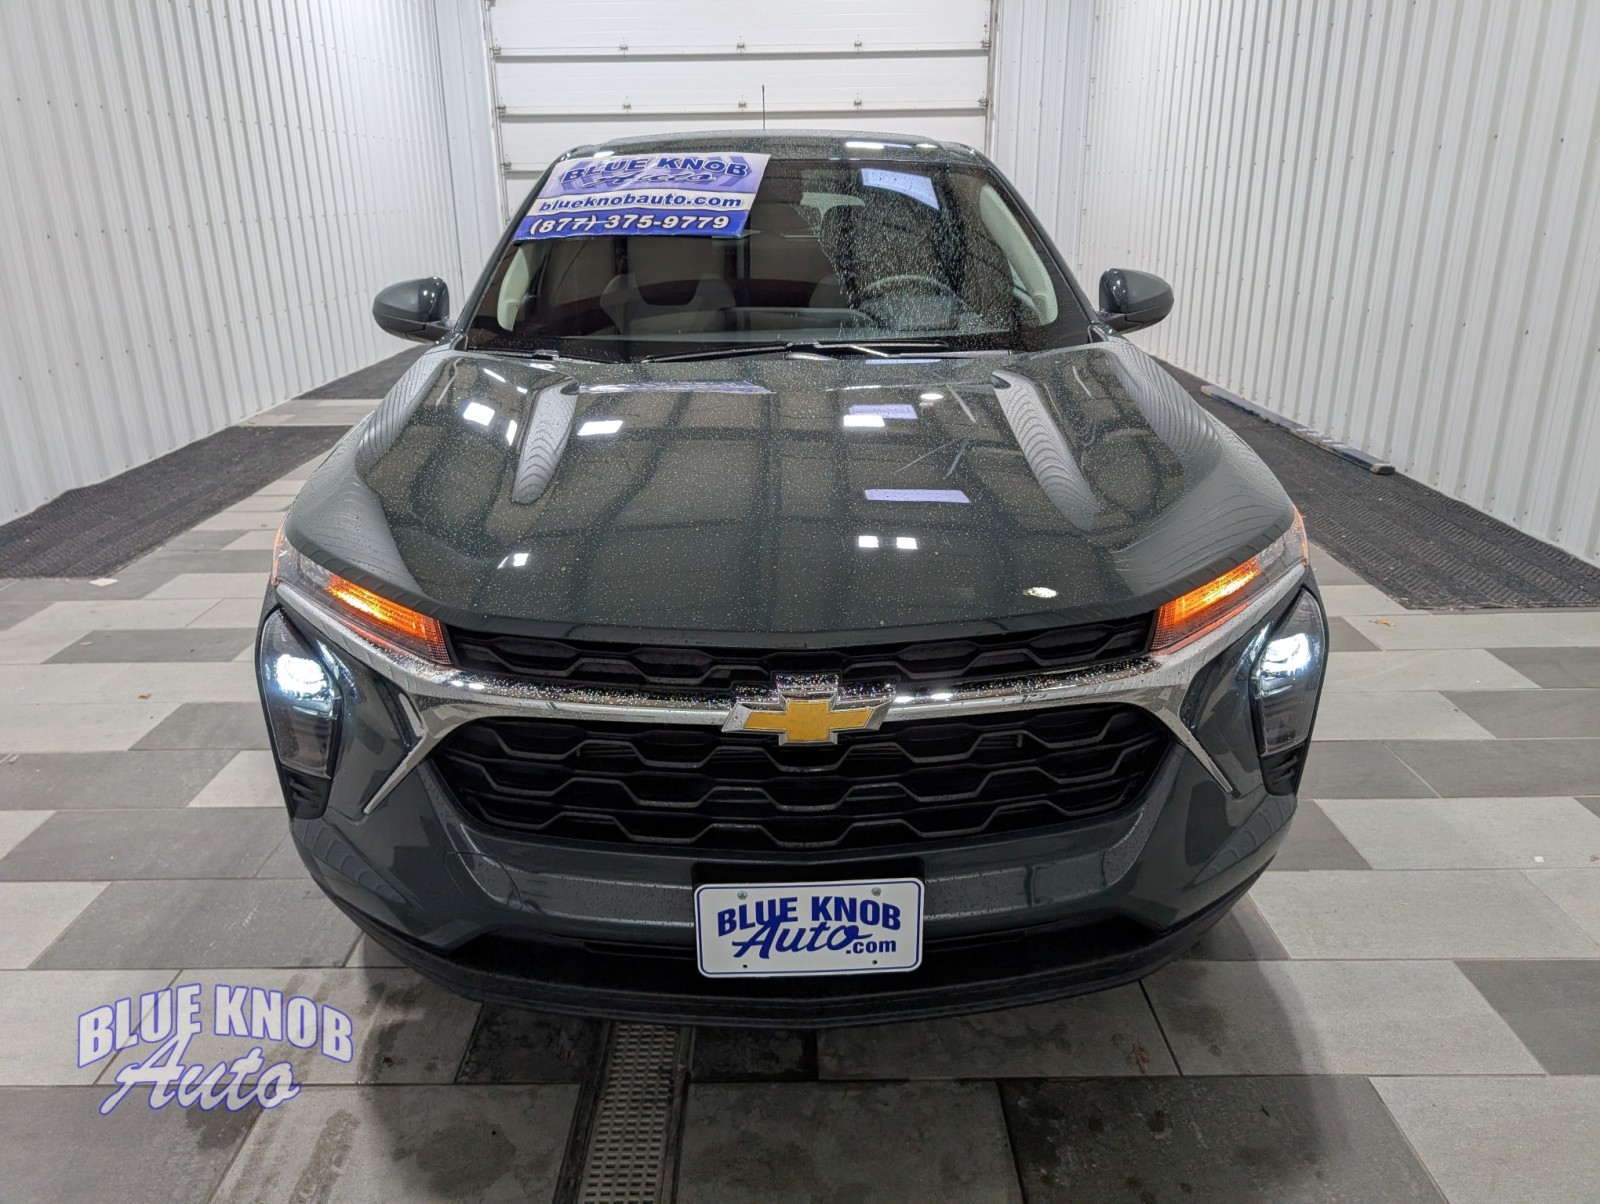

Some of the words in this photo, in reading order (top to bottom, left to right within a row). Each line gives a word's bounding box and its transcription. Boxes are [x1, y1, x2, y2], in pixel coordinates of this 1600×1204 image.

[561, 158, 649, 184] BLUE
[657, 156, 748, 177] KNOB
[582, 170, 717, 188] Auto
[539, 193, 742, 212] blueknobauto.com
[530, 215, 597, 235] (877)
[604, 214, 731, 230] 375-9779
[717, 896, 798, 937] BLUE
[811, 895, 901, 931] KNOB
